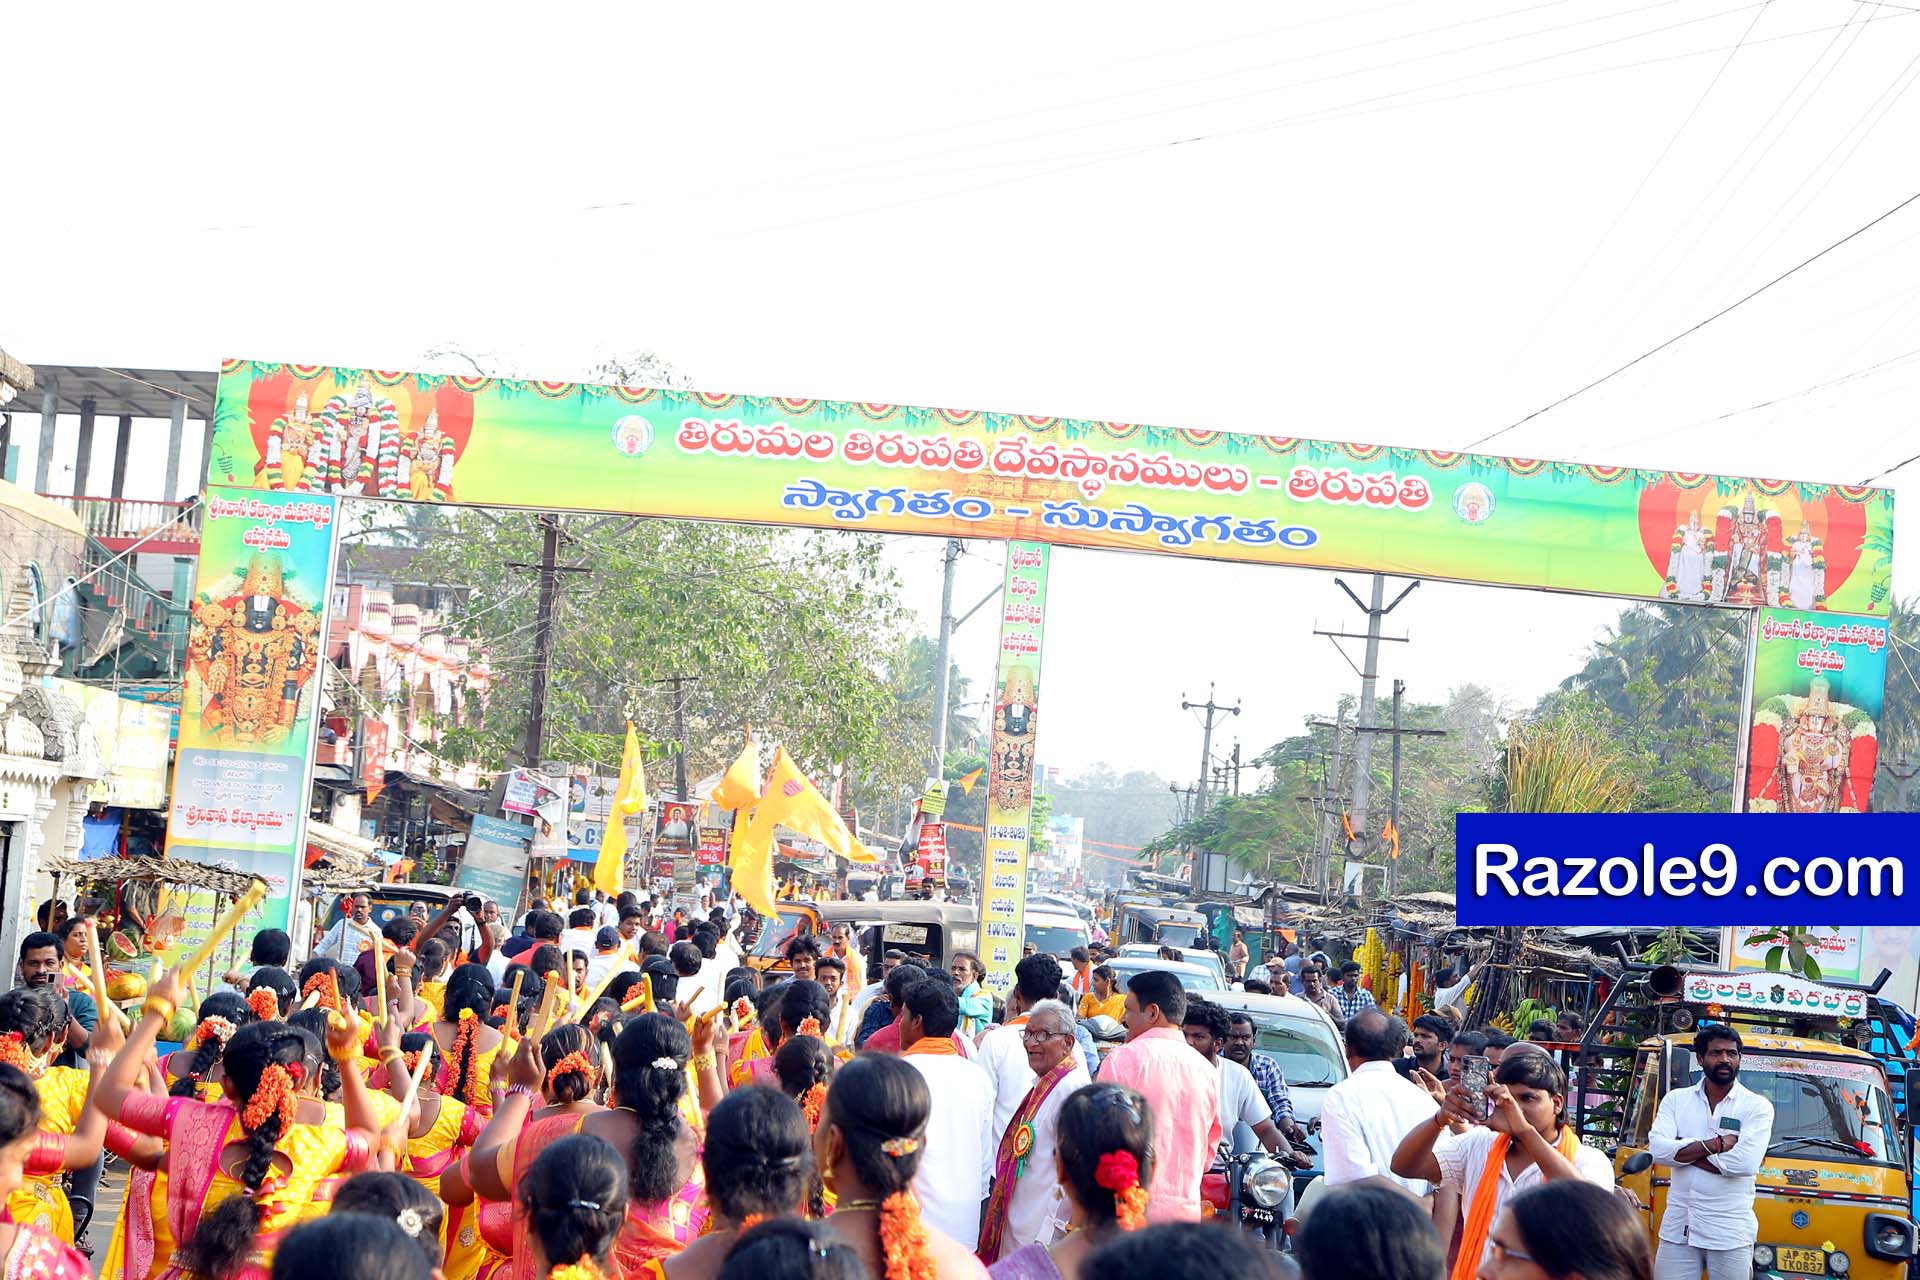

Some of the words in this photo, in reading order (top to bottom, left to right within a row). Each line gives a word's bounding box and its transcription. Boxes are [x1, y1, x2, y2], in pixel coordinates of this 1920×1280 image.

[678, 421, 833, 458] తిరుమల
[844, 432, 984, 470] తిరుపతి
[993, 438, 1248, 497] దేవస్థానములు
[1289, 467, 1431, 507] తిరుపతి
[783, 479, 991, 519] స్వాగతం
[1043, 500, 1318, 547] సుస్వాగతం
[1762, 617, 1801, 641] శ్రీనివాస
